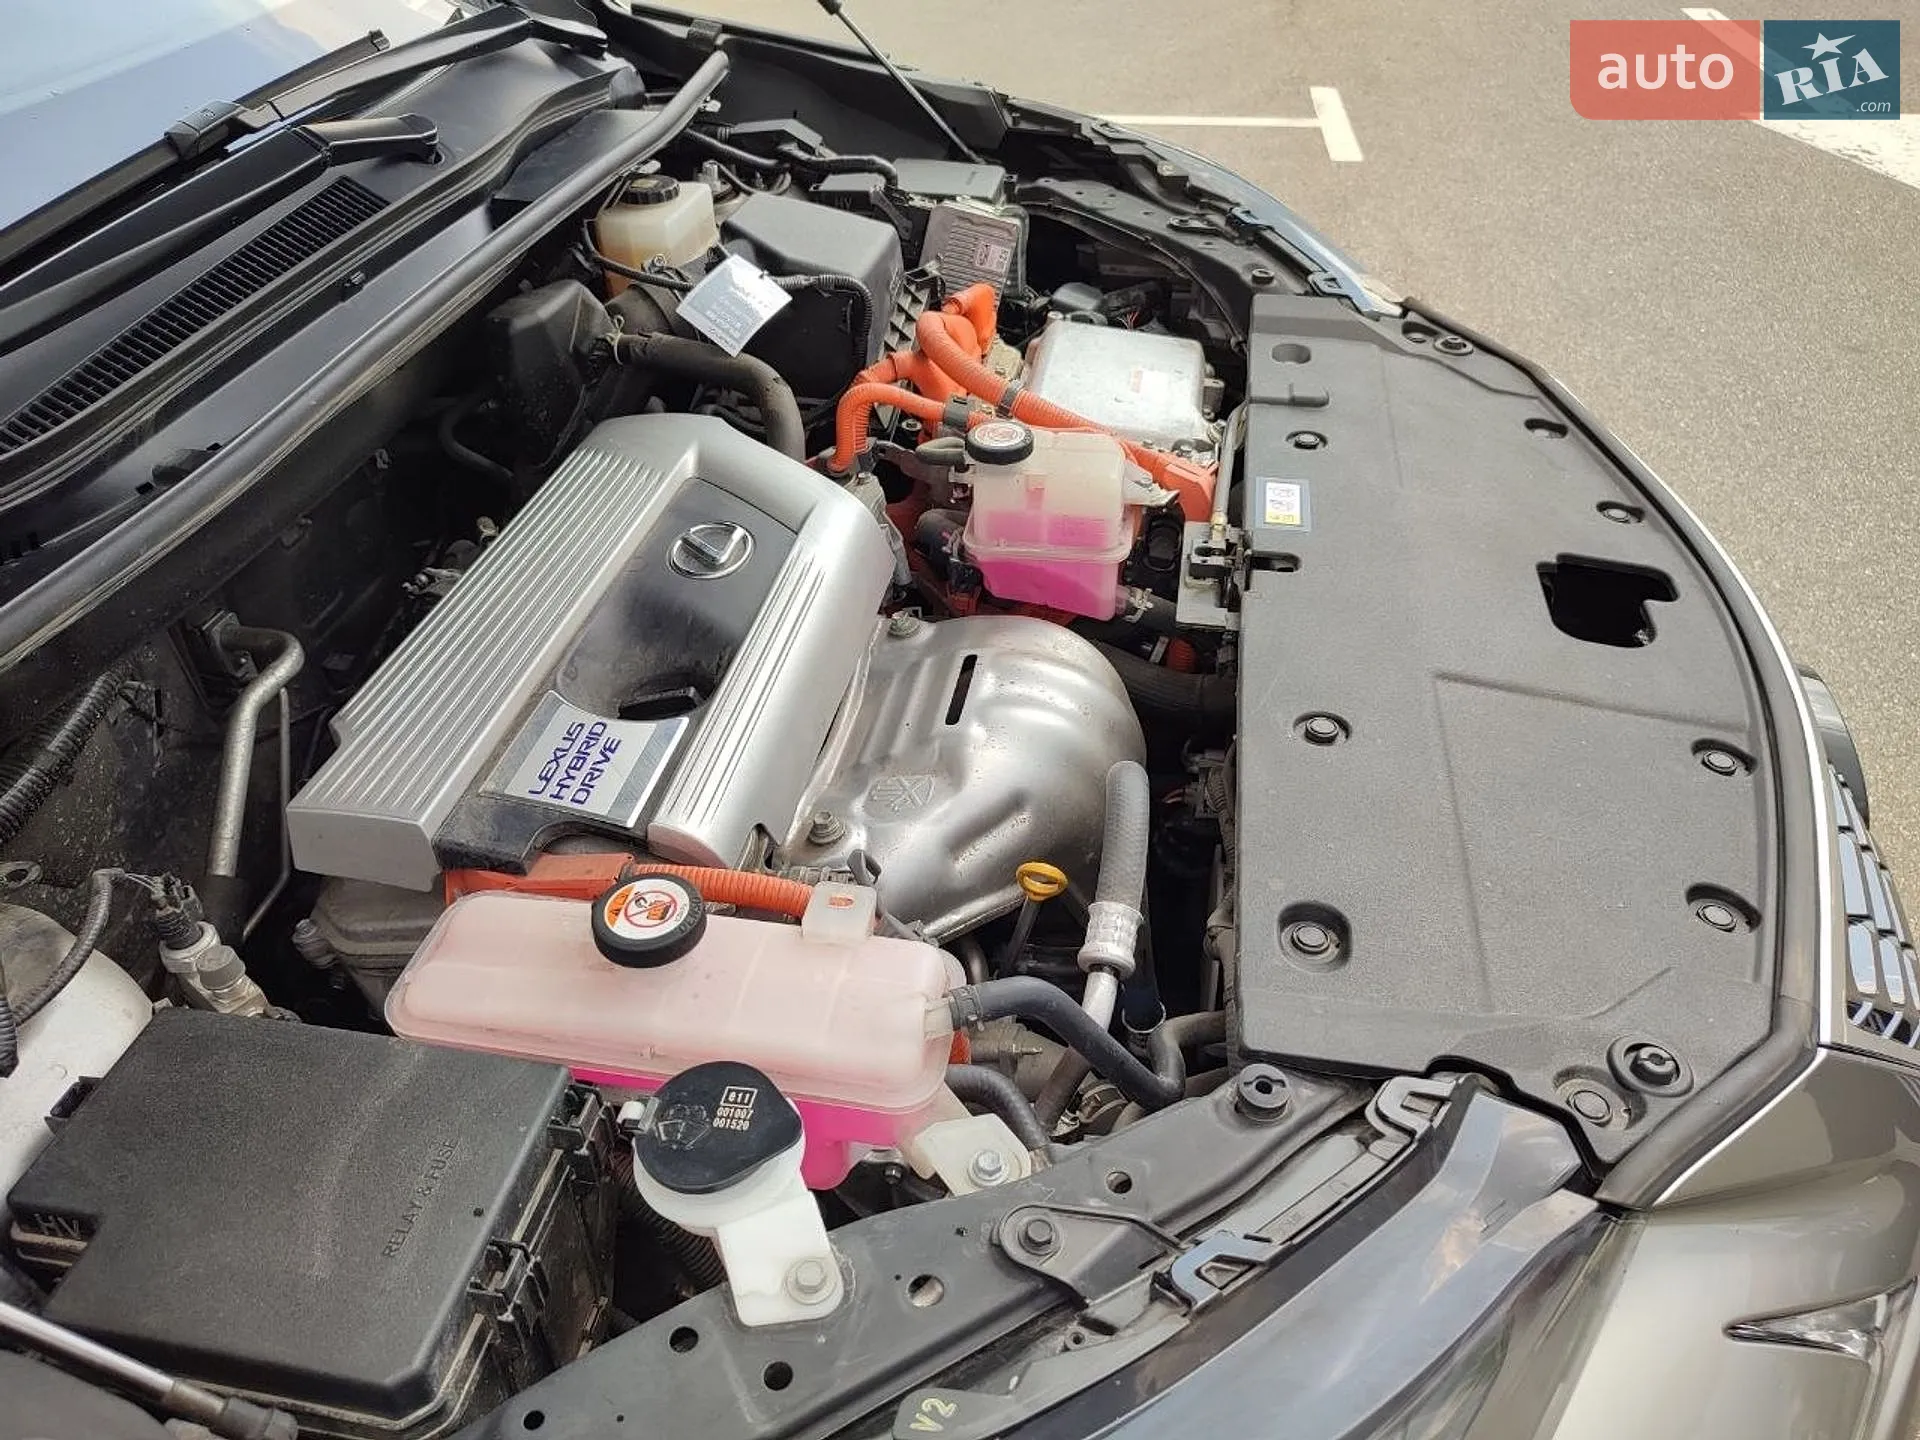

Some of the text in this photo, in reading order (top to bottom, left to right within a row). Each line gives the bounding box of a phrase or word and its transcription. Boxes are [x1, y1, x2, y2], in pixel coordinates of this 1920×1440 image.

[528, 721, 586, 795] LEXUS
[549, 721, 608, 801] HYBRID
[570, 736, 622, 805] DRIVE
[712, 1117, 750, 1131] 001520
[33, 1212, 80, 1240] HV
[383, 1139, 459, 1257] RELAY & FUSE
[909, 1398, 957, 1433] V2
